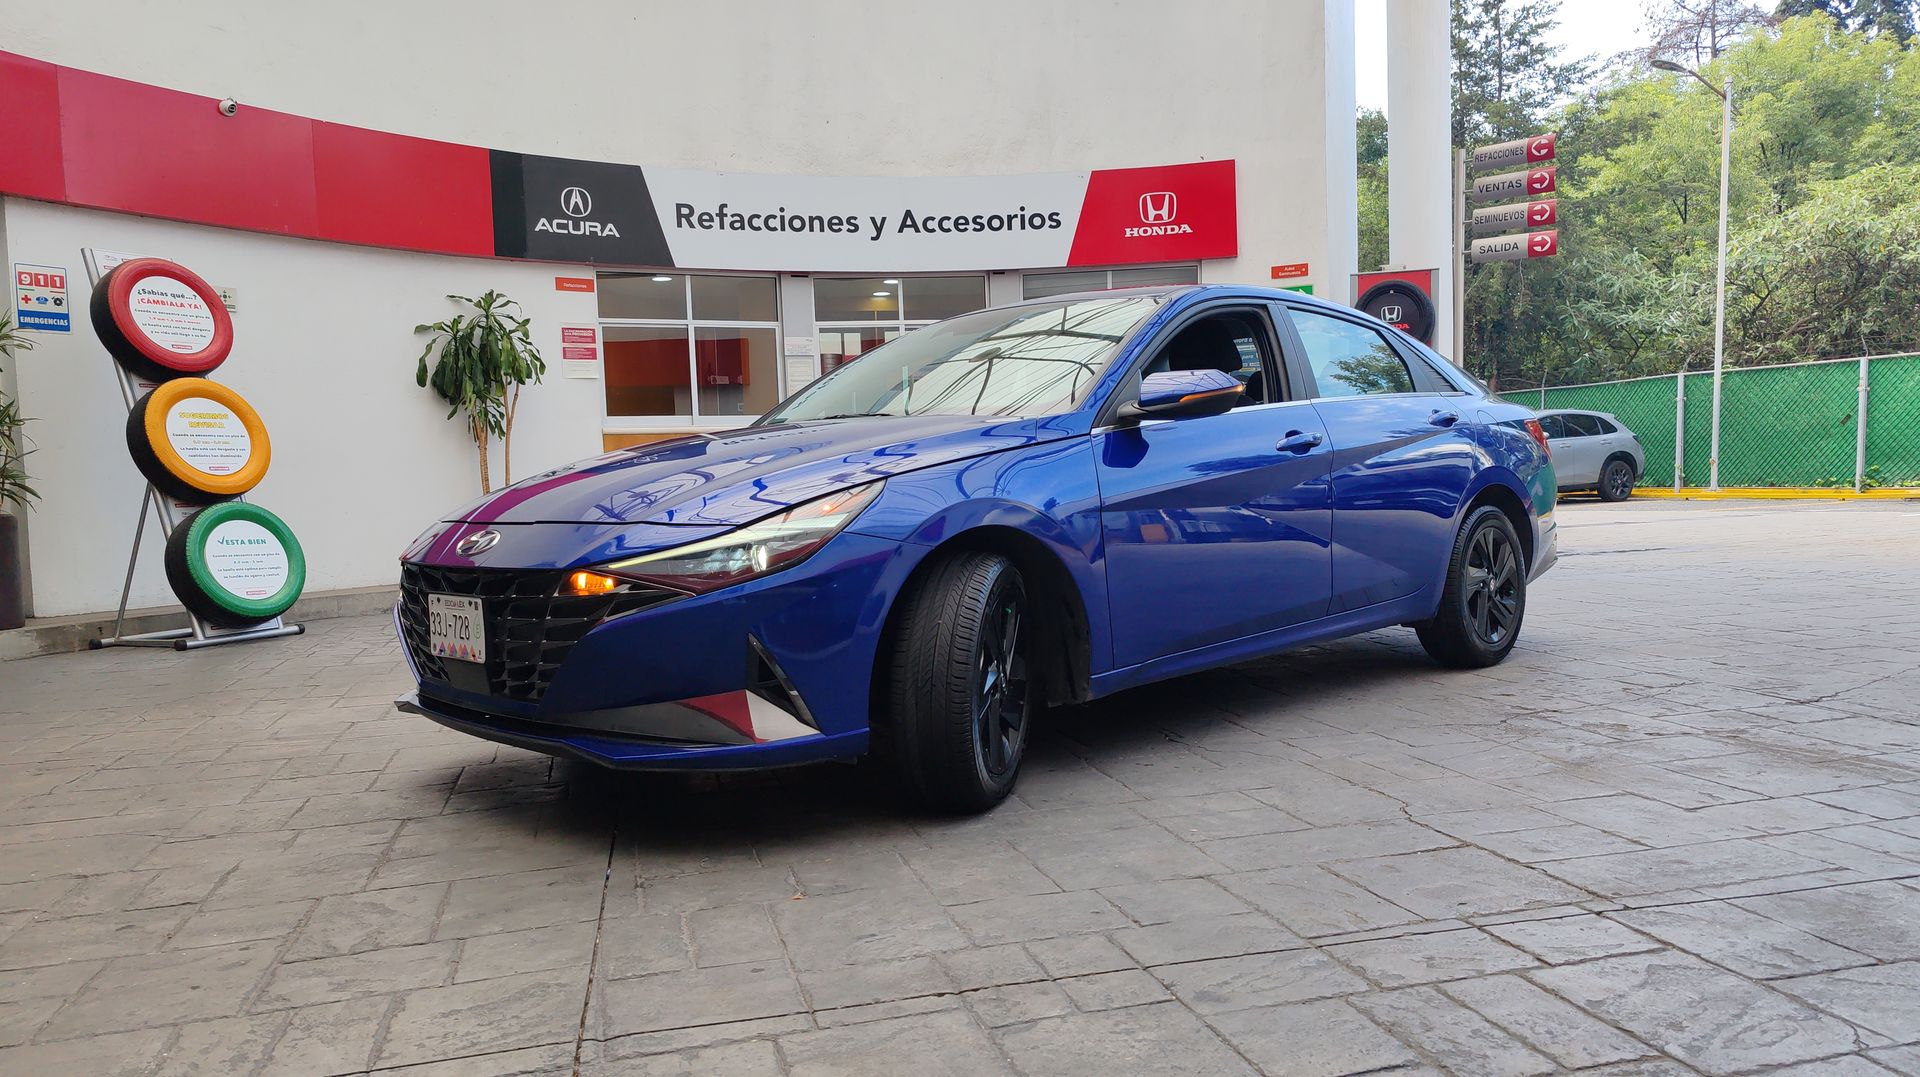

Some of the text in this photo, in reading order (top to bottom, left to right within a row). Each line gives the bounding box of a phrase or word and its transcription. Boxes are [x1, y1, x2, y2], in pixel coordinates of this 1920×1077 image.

[1474, 146, 1524, 163] REFACCIONES
[1478, 179, 1522, 194] VENTAS
[675, 202, 1062, 241] Refacciones y Accesorios
[1474, 210, 1525, 225] SEMINUEVOS
[534, 217, 621, 238] ACURA
[1124, 223, 1193, 238] HONDA
[1479, 242, 1520, 255] SALIDA
[20, 273, 61, 287] 911
[20, 316, 68, 326] EMERGENCIAS
[431, 612, 470, 640] 33J-728
